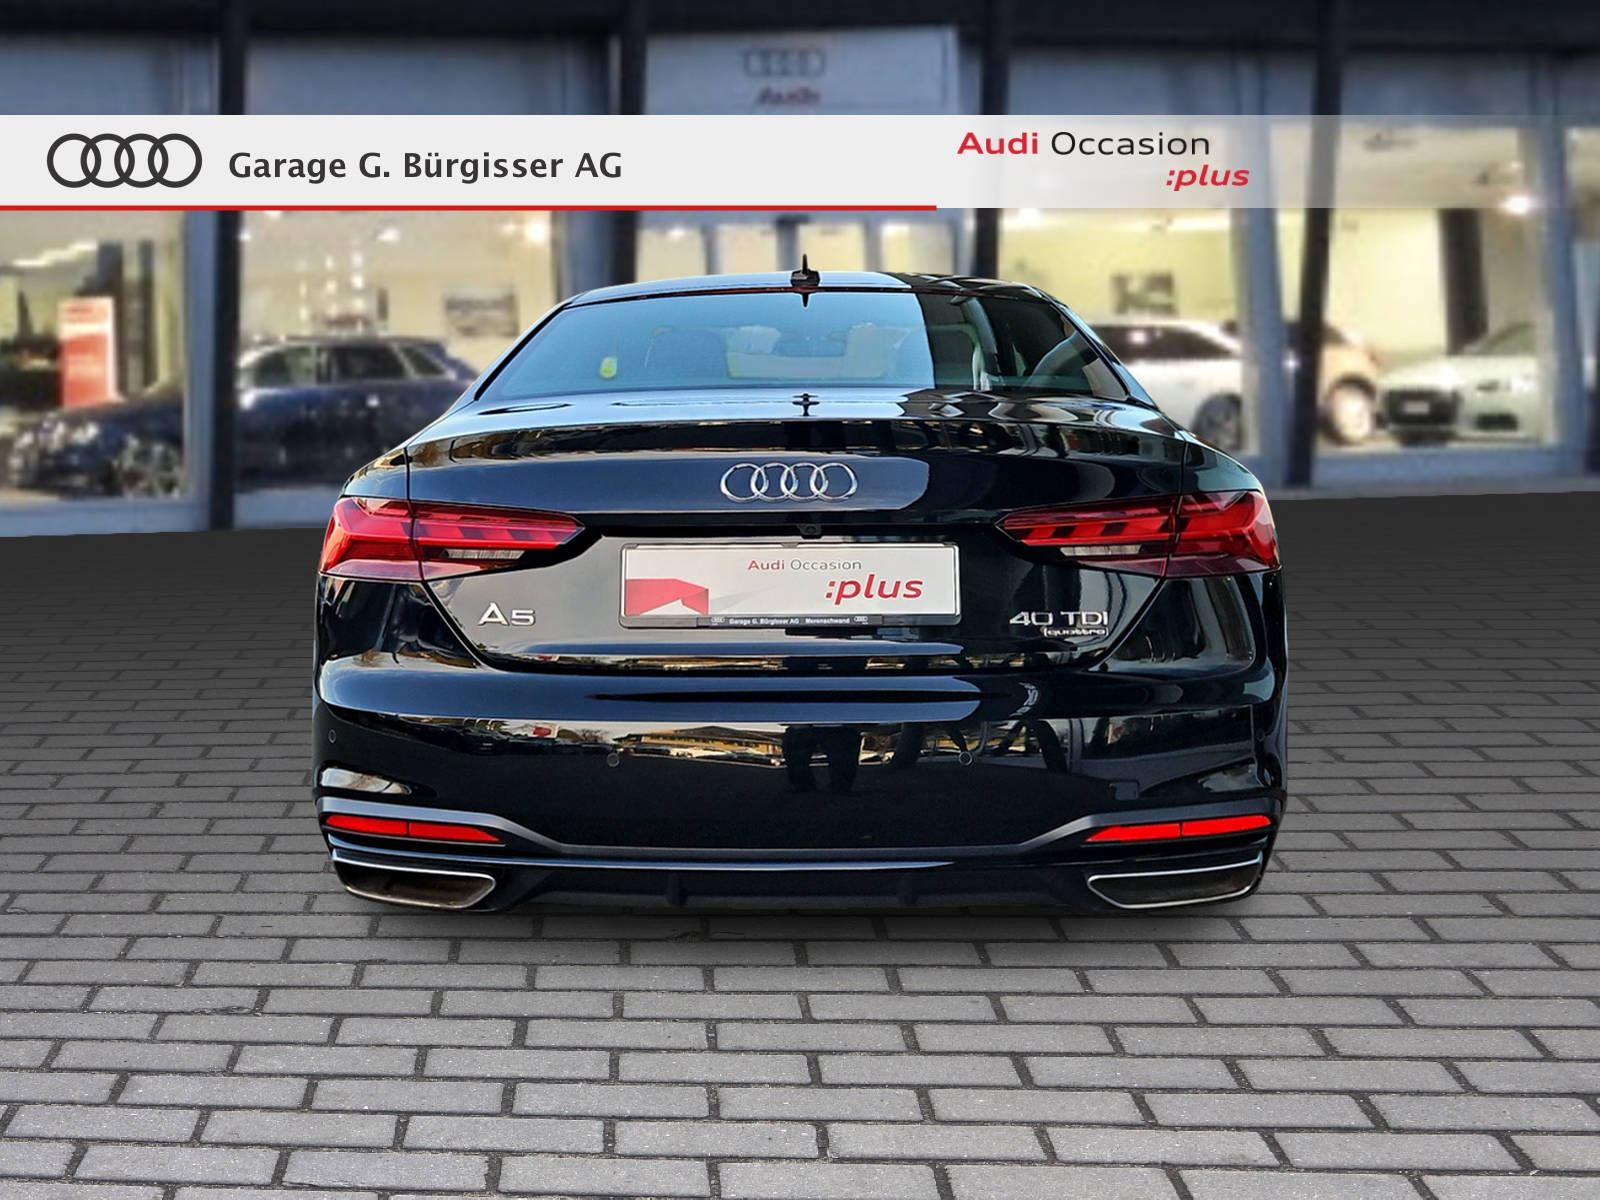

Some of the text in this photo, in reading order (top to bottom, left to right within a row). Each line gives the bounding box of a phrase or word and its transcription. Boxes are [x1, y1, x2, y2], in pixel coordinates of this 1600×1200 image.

[747, 559, 862, 571] Audi Occasion
[825, 574, 924, 605] :plus
[478, 602, 535, 626] A5
[729, 617, 750, 625] Garage
[1009, 611, 1109, 626] 40 TDI
